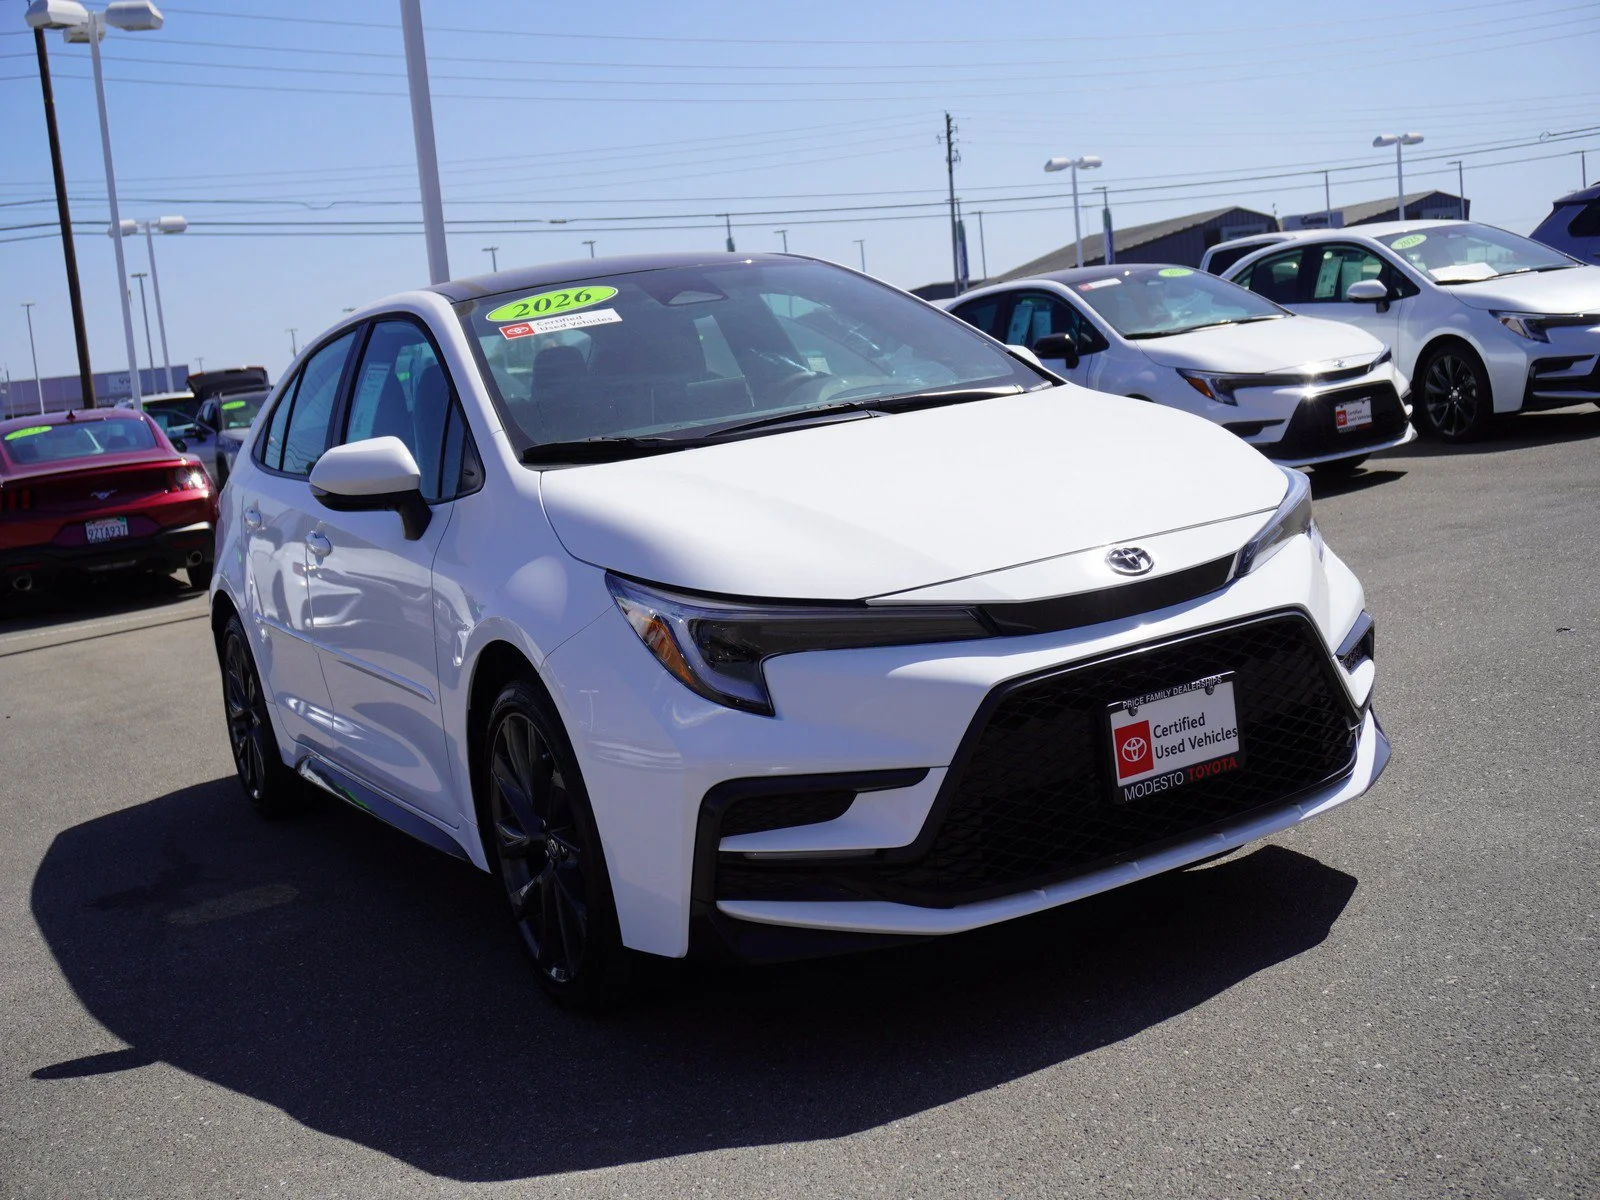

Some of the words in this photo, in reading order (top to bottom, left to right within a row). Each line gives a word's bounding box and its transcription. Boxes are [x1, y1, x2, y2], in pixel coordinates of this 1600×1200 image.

[513, 288, 592, 318] 2026
[536, 315, 583, 326] Certified
[539, 323, 567, 331] Used
[567, 316, 613, 328] Vehicles
[1122, 698, 1144, 710] PRICE
[1146, 690, 1171, 702] FAMILY
[1173, 676, 1222, 696] DEALERSHIPS
[1153, 712, 1206, 738] Certified
[1155, 739, 1186, 759] Used
[1188, 727, 1238, 750] Vehicles
[1124, 771, 1184, 801] MODESTO
[1188, 756, 1238, 781] TOYOTA
